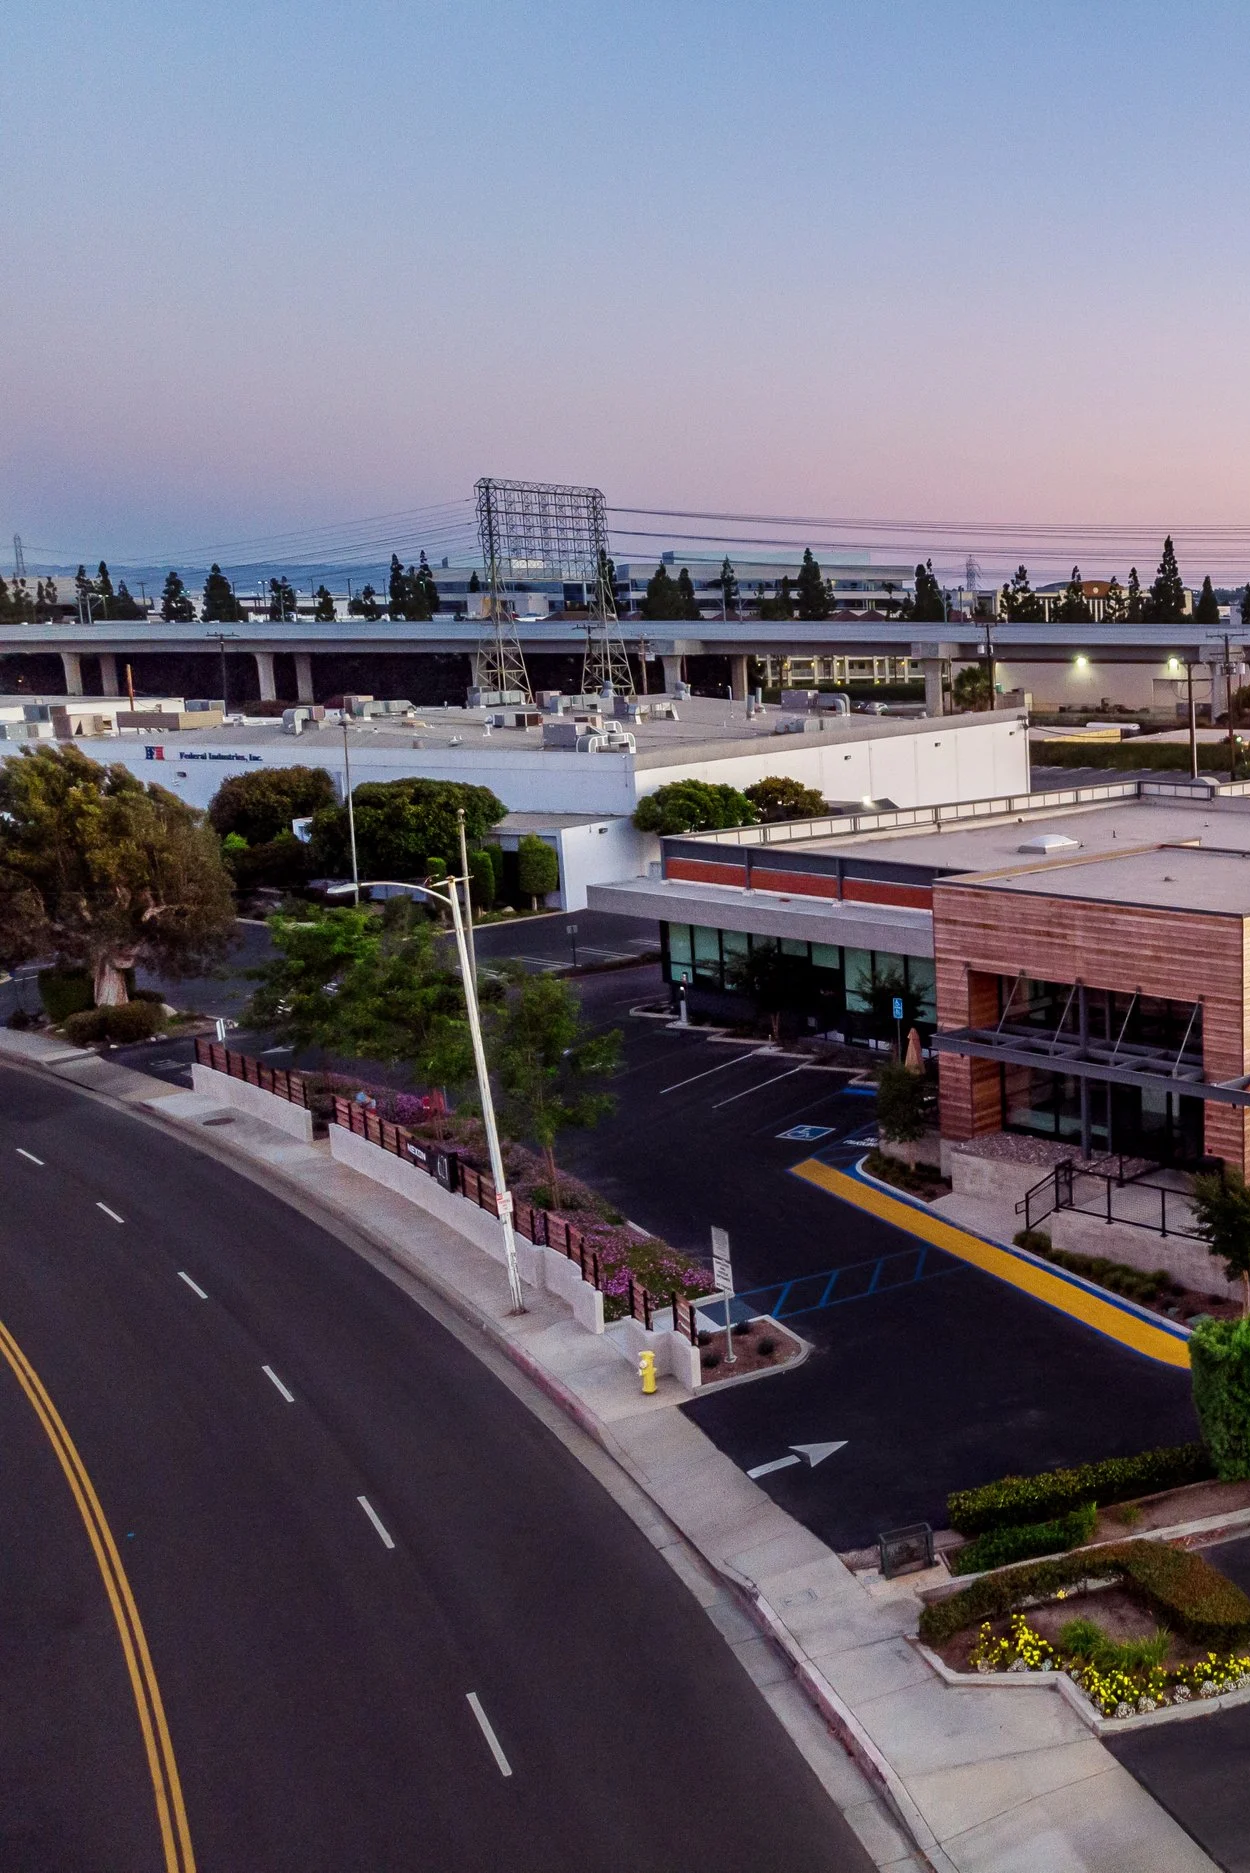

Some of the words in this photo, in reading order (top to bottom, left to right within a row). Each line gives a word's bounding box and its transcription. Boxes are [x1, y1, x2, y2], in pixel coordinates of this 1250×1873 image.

[179, 752, 207, 760] Federal
[208, 753, 248, 762] Industries,
[249, 753, 263, 762] Inc.
